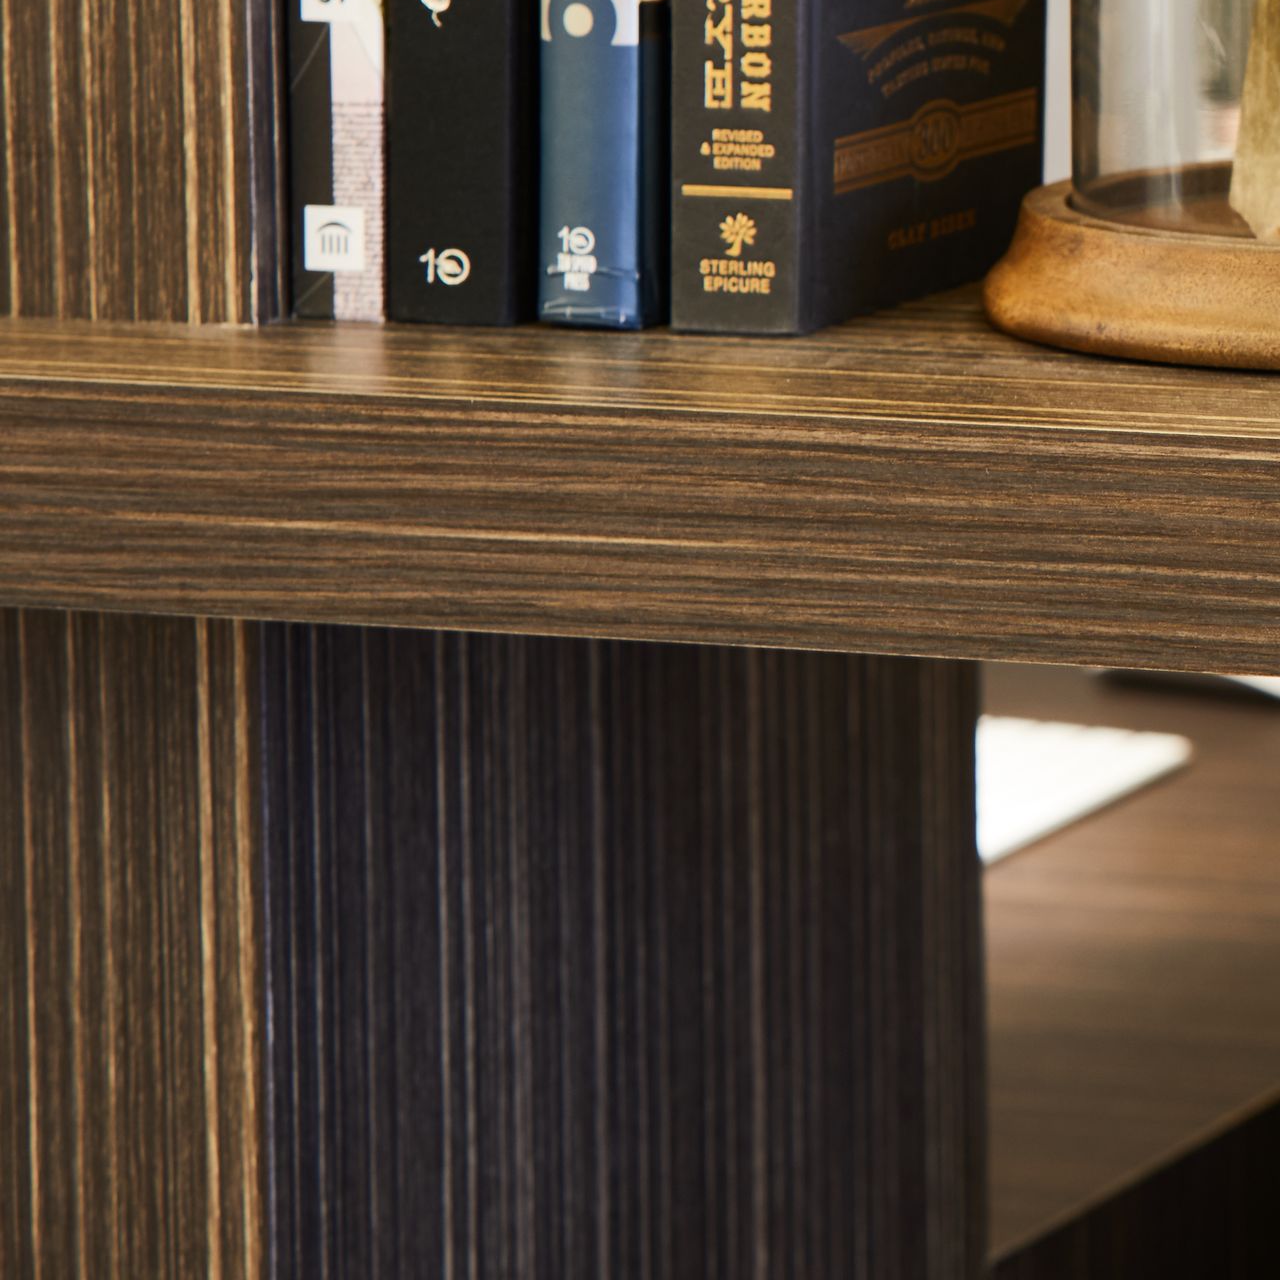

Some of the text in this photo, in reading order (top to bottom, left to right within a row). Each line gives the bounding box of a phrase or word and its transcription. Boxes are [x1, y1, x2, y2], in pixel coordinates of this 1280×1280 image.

[712, 127, 764, 143] REVISED
[712, 142, 775, 158] EXPANDED
[713, 156, 761, 171] EDITION
[699, 258, 776, 278] STERLING
[703, 276, 771, 295] EPICURE
